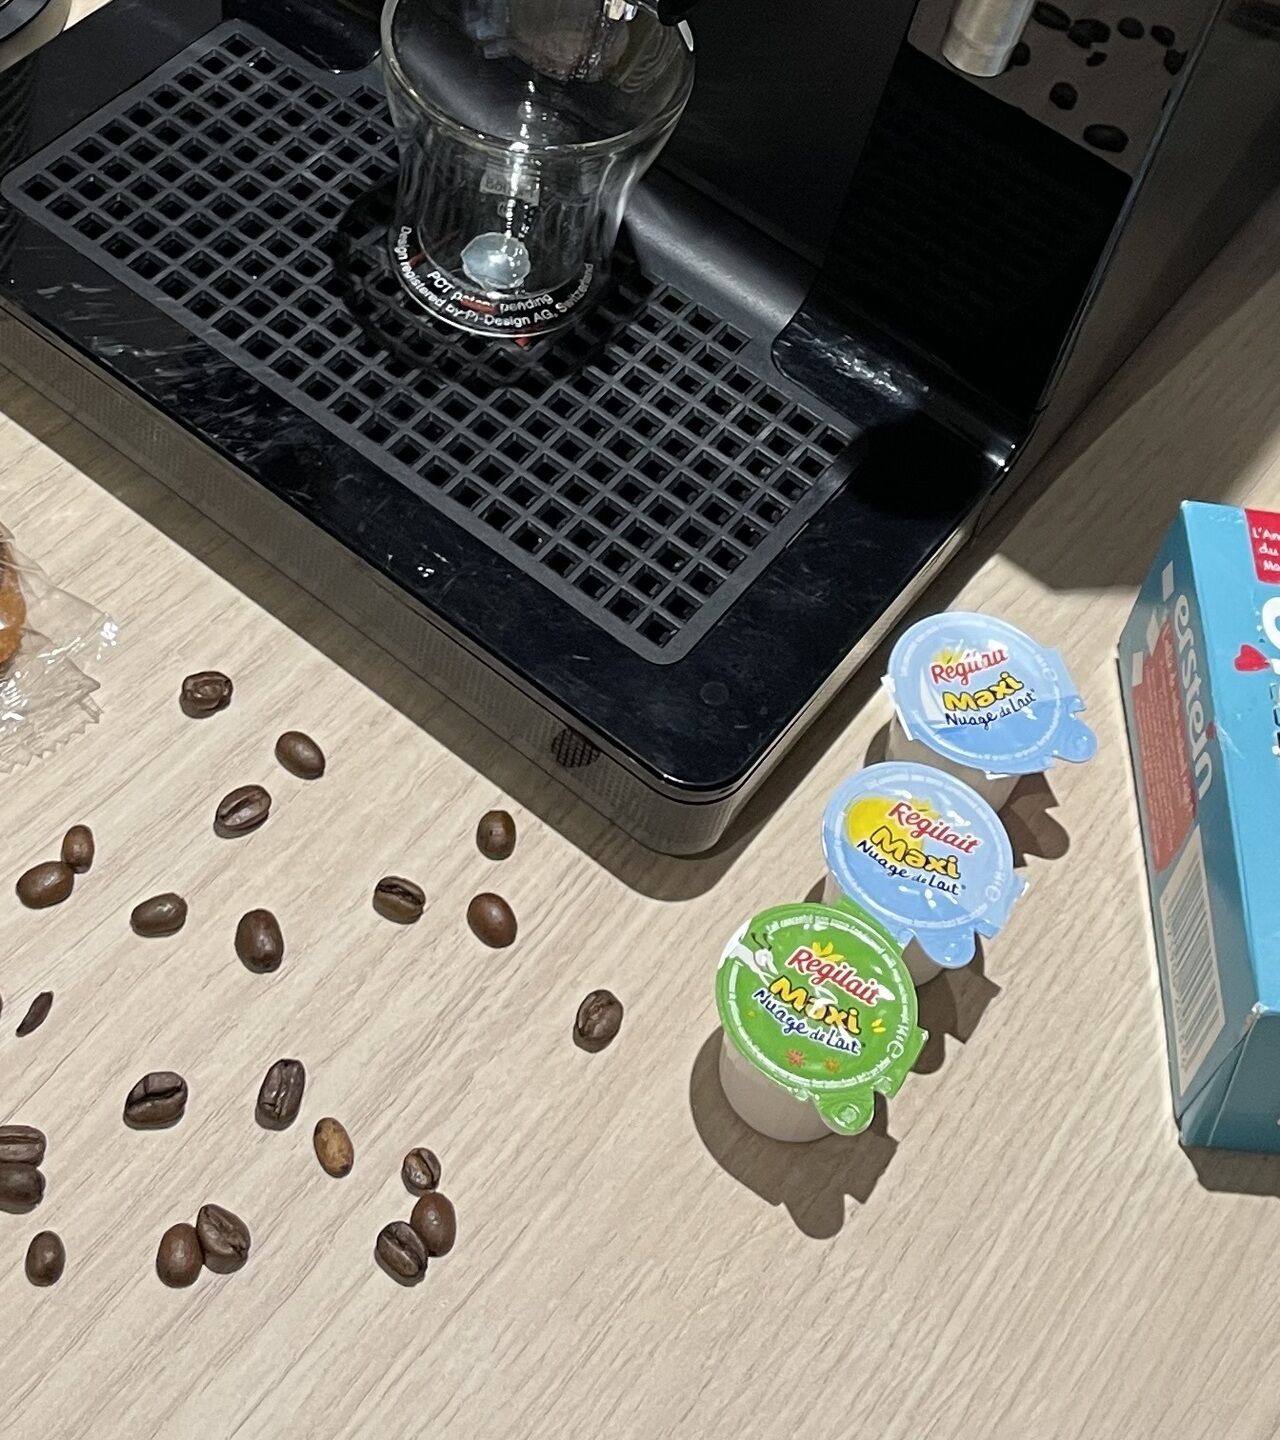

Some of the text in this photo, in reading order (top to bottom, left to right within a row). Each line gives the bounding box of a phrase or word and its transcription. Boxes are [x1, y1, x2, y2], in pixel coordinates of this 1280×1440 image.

[394, 226, 412, 260] Design
[400, 261, 445, 306] registered
[427, 270, 455, 294] PCT
[499, 294, 554, 314] pending
[1259, 543, 1279, 556] du
[942, 671, 1024, 712] Maxi
[1175, 595, 1213, 800] erstein
[945, 710, 998, 731] Nuage
[857, 840, 960, 896] Nuage de Lait
[870, 825, 961, 880] Maxi
[754, 990, 859, 1055] Nuage de Lait
[770, 975, 861, 1035] Maxi
